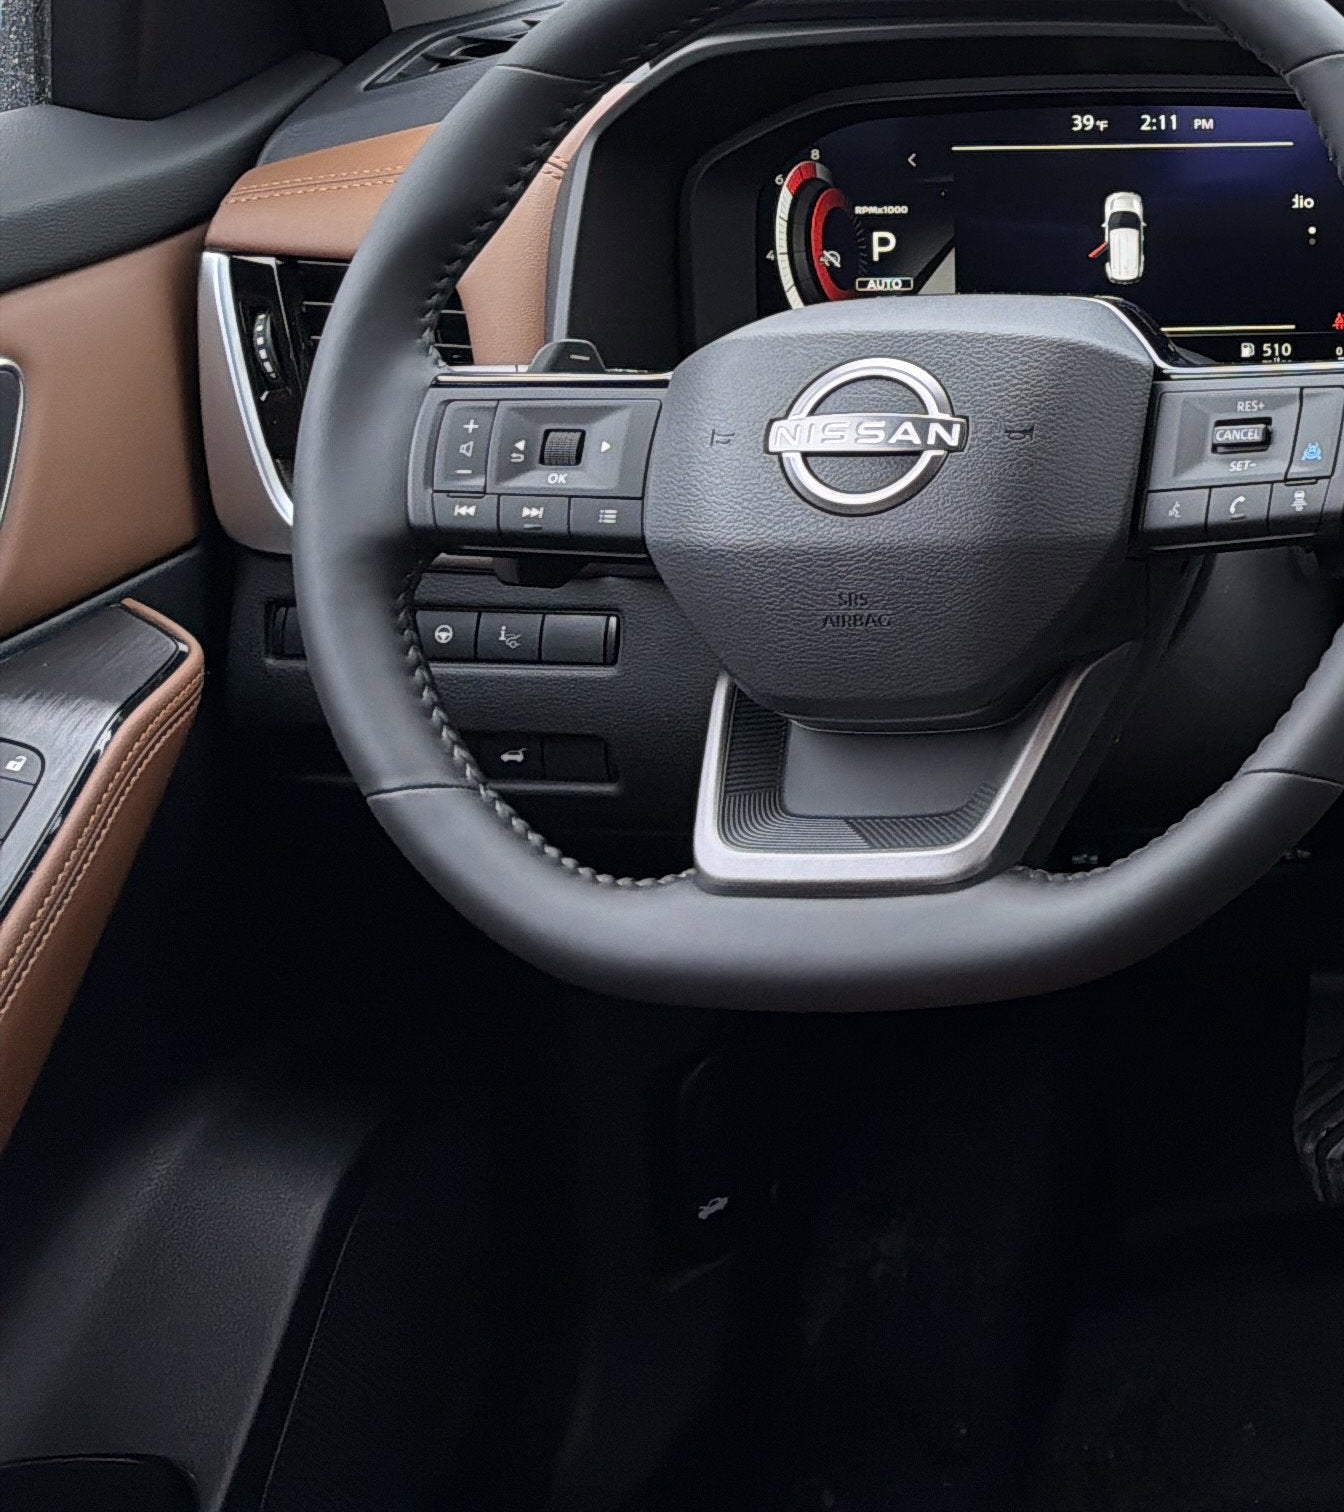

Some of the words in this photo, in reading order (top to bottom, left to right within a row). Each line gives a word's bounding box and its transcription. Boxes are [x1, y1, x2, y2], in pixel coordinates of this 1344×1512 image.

[1140, 114, 1177, 131] 2:11
[1193, 118, 1214, 130] PM
[810, 149, 820, 160] 8
[775, 174, 784, 185] 6
[872, 231, 897, 262] P
[766, 250, 775, 261] 4
[867, 279, 902, 289] AUTO
[1262, 343, 1292, 356] 510
[1237, 400, 1265, 412] RES+
[775, 420, 961, 447] NISSAN
[1215, 428, 1260, 442] CANCEL
[547, 473, 568, 485] OK
[838, 592, 868, 607] SRS
[822, 613, 891, 628] AIRBAG
